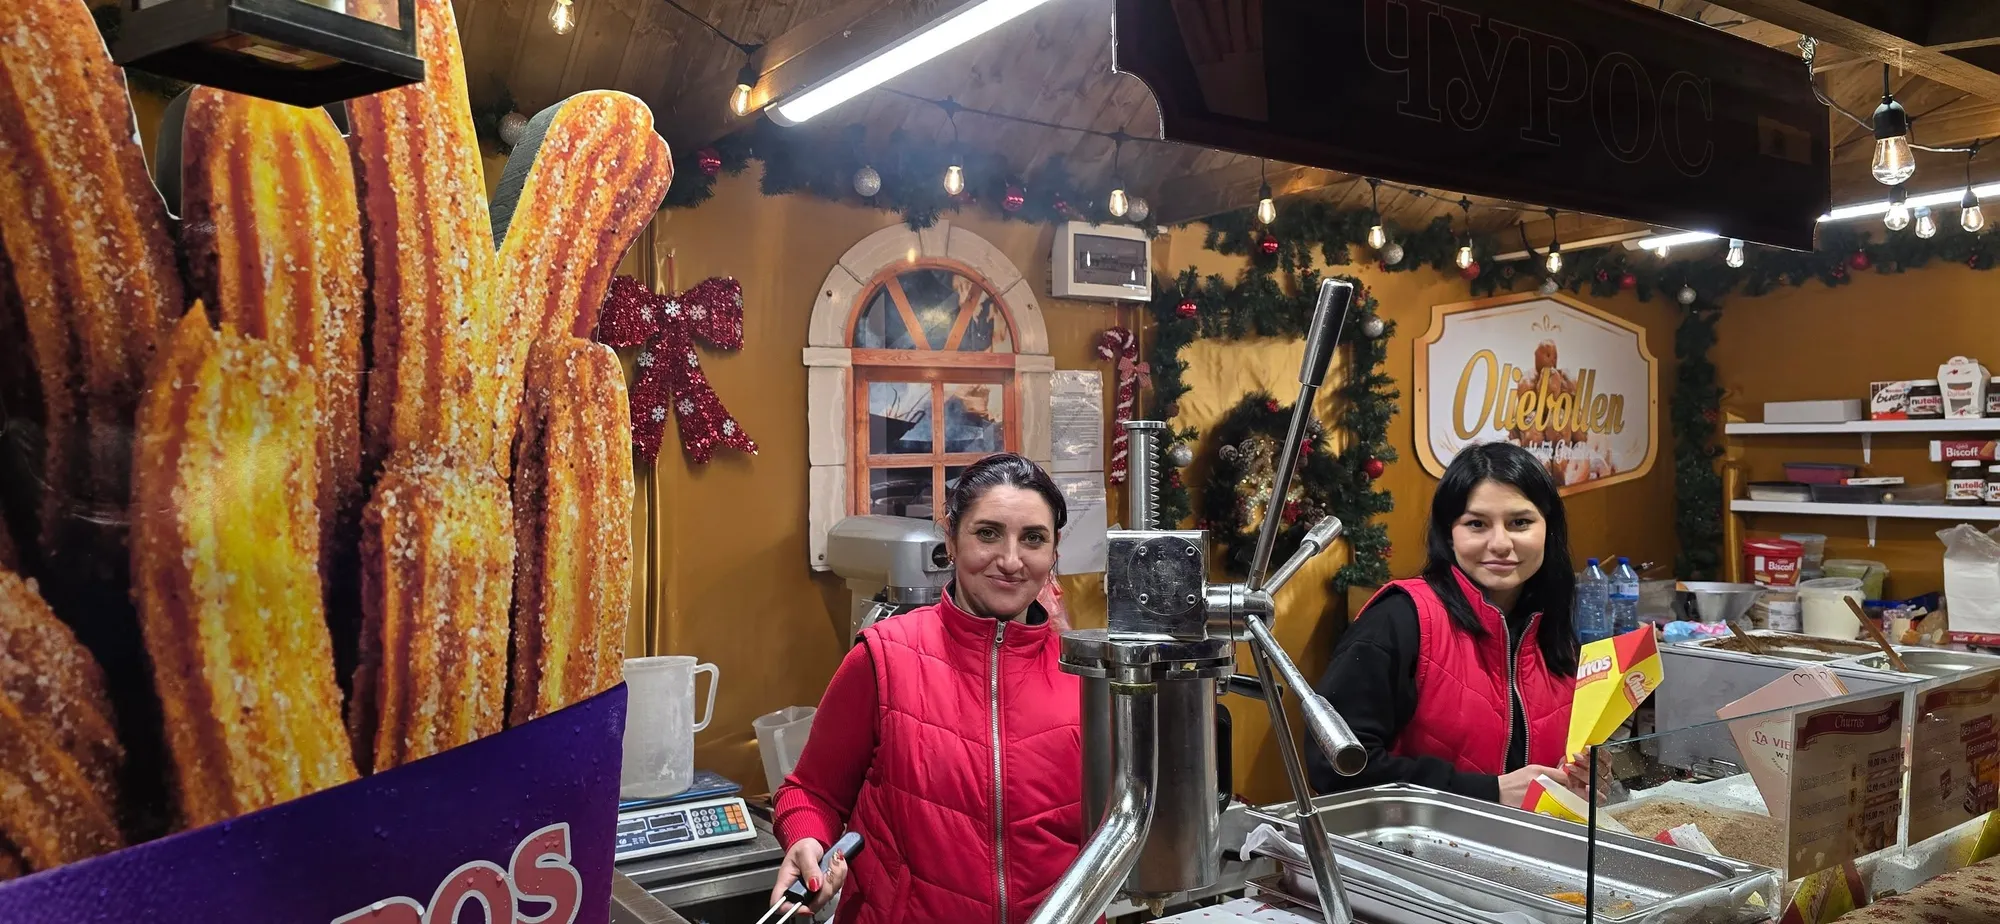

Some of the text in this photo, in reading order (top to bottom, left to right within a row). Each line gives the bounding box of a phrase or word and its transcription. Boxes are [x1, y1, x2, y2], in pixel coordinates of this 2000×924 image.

[1364, 0, 1715, 178] ЧУРОС
[1452, 349, 1625, 440] Oliebollen
[1876, 392, 1907, 404] buen
[1946, 447, 1978, 457] Biscoff
[1768, 561, 1796, 571] Biscoff
[1834, 714, 1865, 729] Churros
[331, 822, 582, 924] OS
